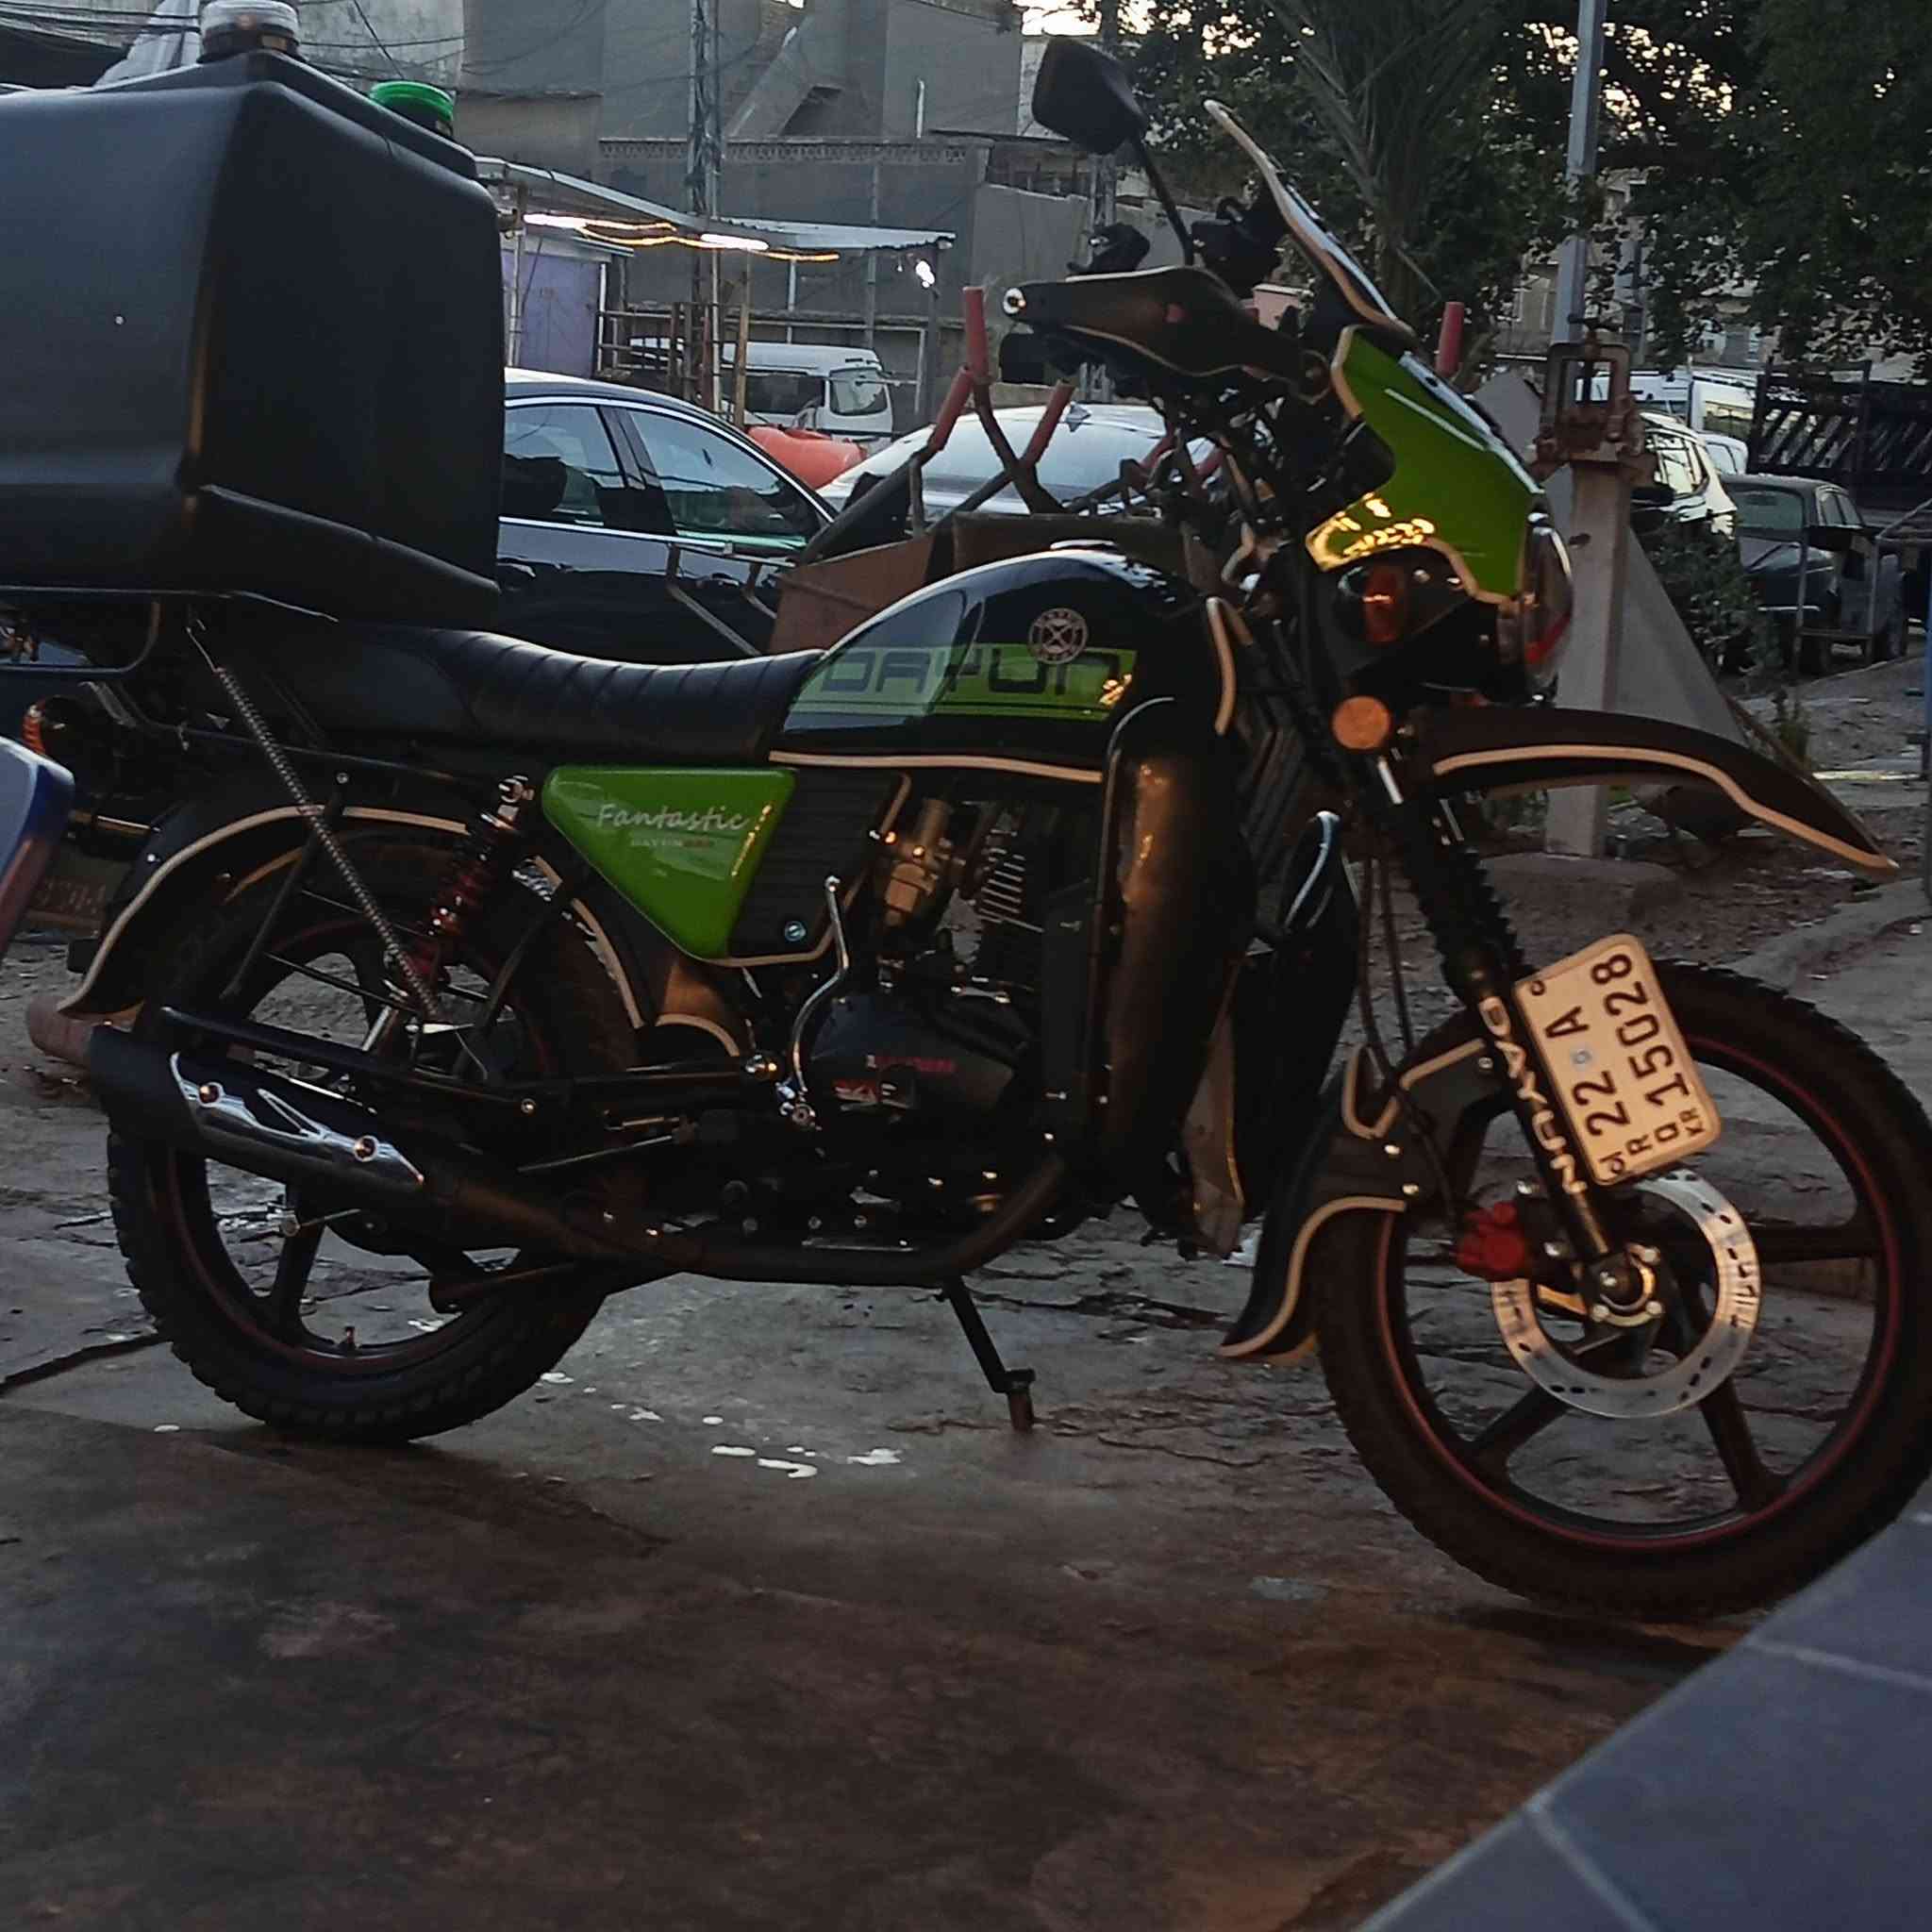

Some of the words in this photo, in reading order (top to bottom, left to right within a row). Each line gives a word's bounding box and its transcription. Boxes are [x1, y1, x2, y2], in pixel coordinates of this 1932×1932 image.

[597, 803, 749, 830] Fantastic
[1545, 1007, 1590, 1039] A
[1591, 954, 1690, 1107] 15028
[1478, 995, 1588, 1193] DAYUN
[1572, 1071, 1630, 1136] 22
